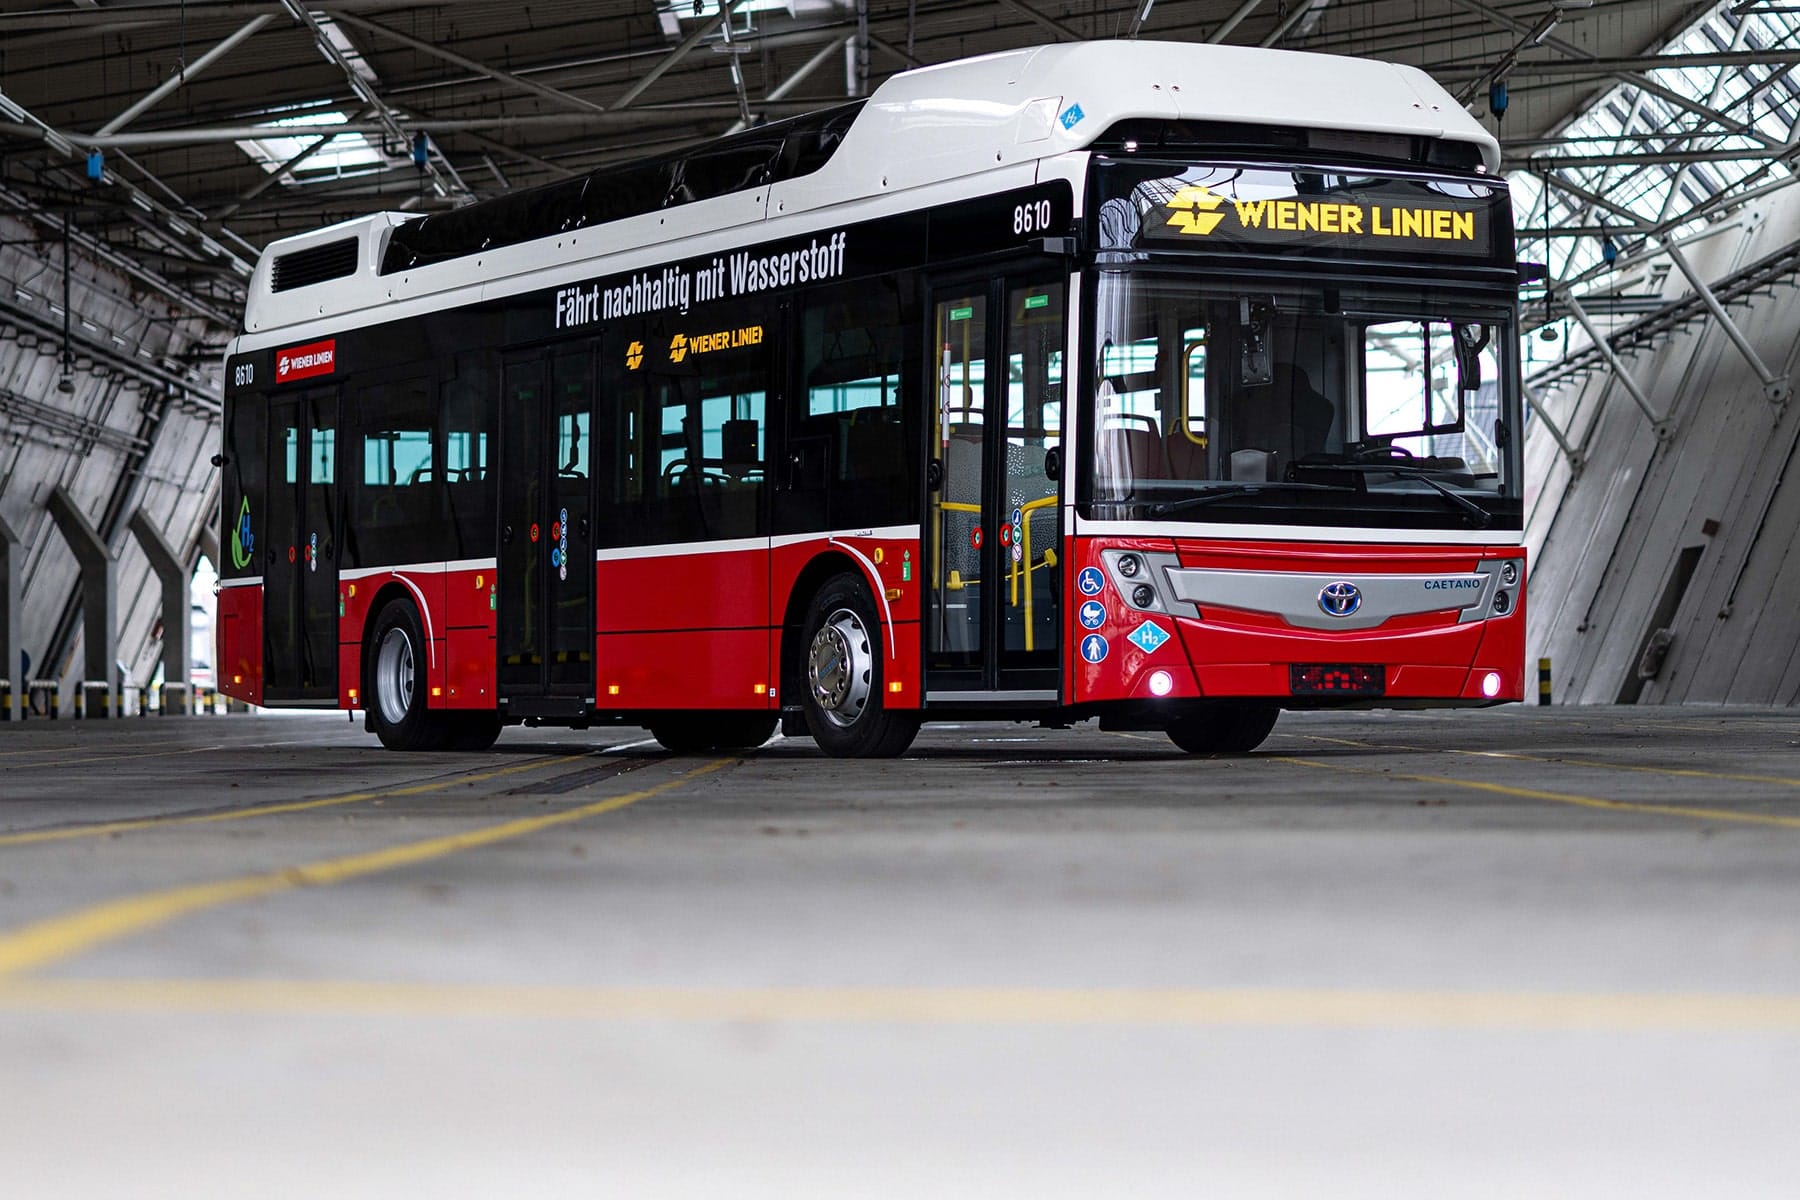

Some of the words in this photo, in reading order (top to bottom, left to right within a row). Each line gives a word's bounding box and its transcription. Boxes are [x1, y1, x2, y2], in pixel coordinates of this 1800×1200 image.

[1014, 200, 1050, 234] 8610
[1234, 198, 1363, 234] WIENER
[1371, 206, 1474, 240] LINIEN
[555, 284, 599, 328] Fährt
[602, 265, 689, 316] nachhaltig
[695, 258, 725, 302] mit
[730, 231, 846, 296] Wasserstoff
[689, 331, 730, 354] WIENER
[291, 354, 313, 370] WIENER
[313, 350, 333, 366] LINIEN
[235, 363, 254, 387] 8610
[1424, 579, 1480, 590] CAETANO
[1141, 630, 1159, 645] H2
